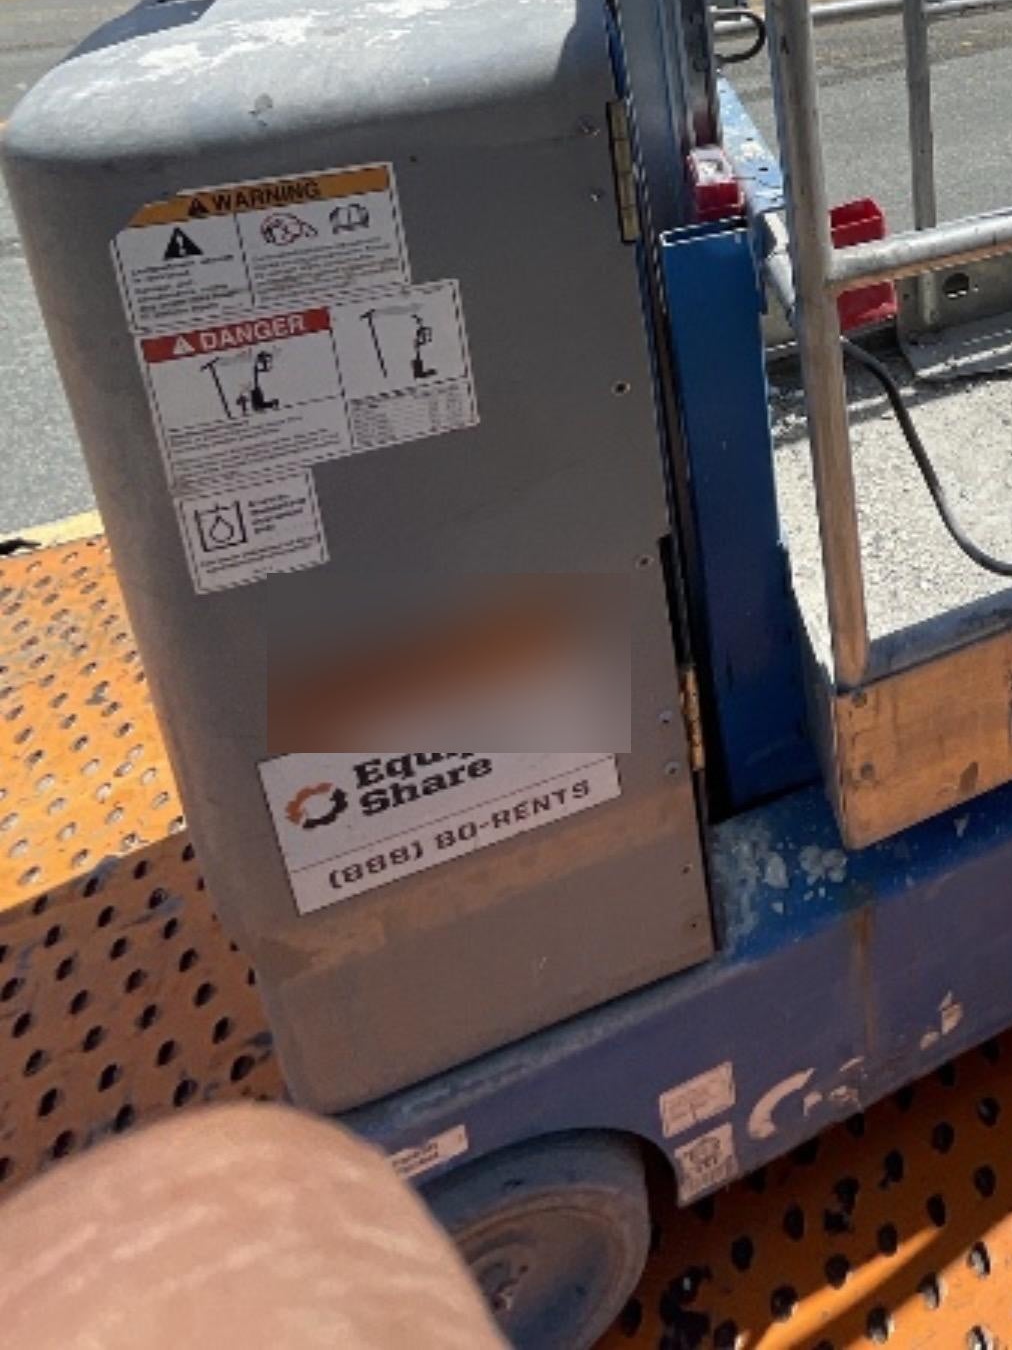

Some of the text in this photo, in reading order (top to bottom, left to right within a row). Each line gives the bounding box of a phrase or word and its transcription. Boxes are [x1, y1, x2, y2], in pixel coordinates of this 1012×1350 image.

[213, 180, 320, 212] WARNING
[200, 315, 306, 350] DANGER
[359, 757, 492, 817] Share
[328, 841, 424, 889] (888)
